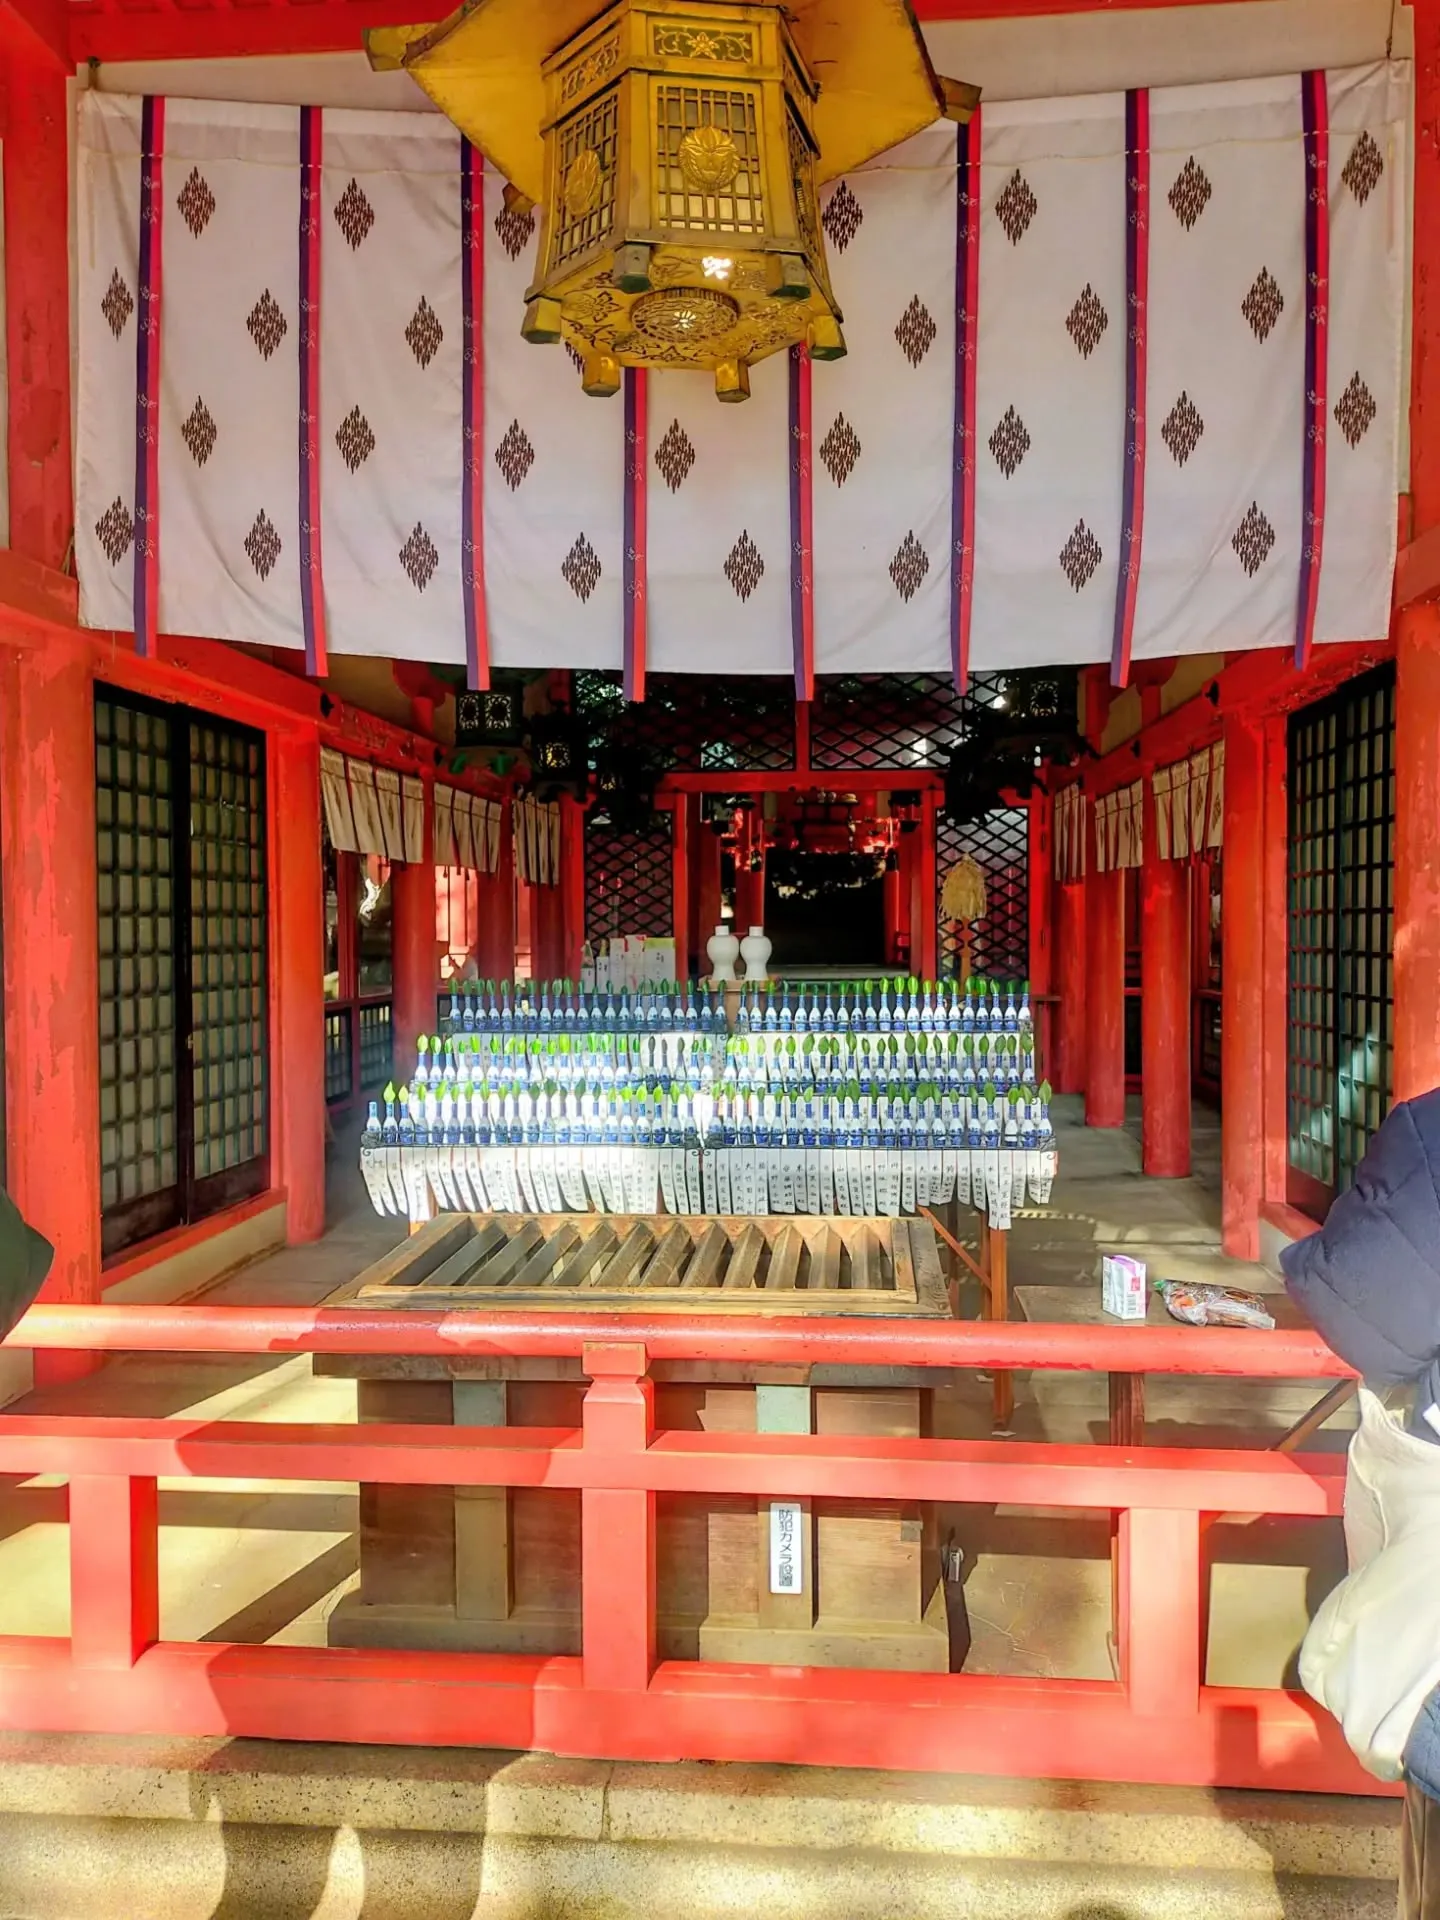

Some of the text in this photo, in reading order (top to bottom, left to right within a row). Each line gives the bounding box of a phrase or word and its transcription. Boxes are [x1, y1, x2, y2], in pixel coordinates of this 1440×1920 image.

[779, 1509, 793, 1586] 防犯カメラ設置
